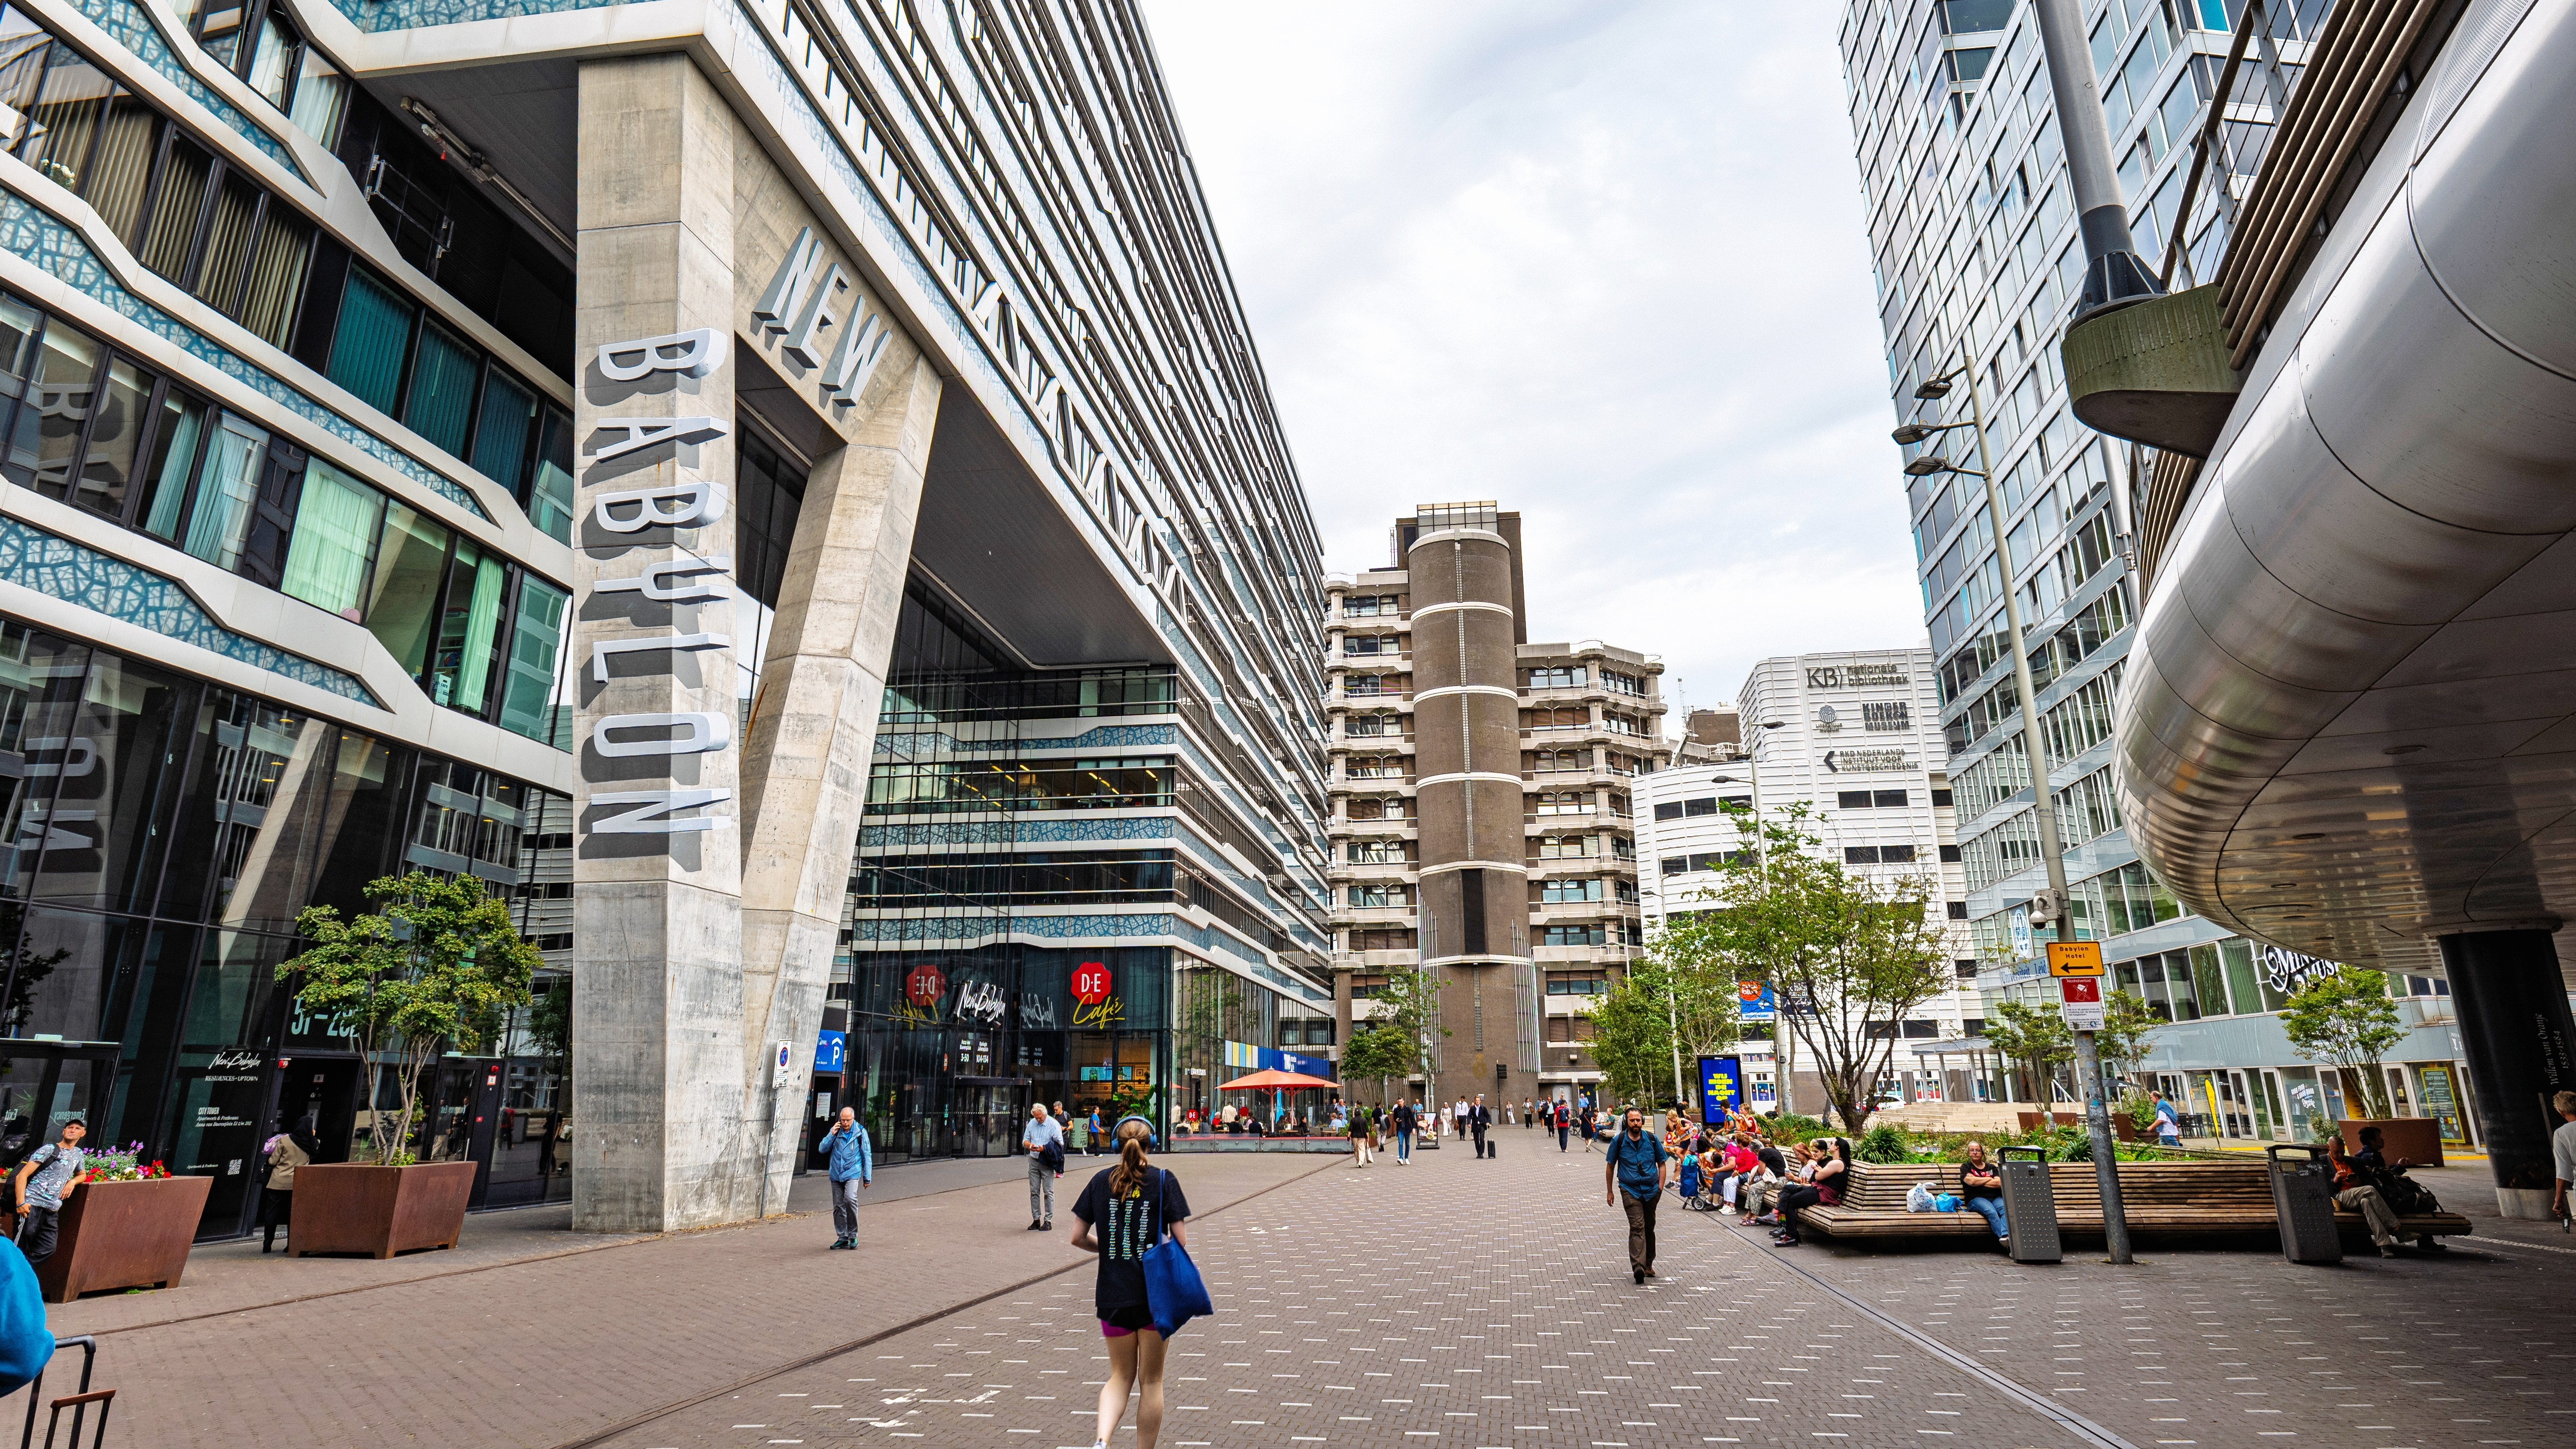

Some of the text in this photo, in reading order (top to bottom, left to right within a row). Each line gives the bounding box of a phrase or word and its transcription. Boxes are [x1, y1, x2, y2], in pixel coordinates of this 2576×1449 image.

[751, 226, 893, 407] NEW
[591, 327, 731, 834] BABYLON
[1847, 662, 1897, 674] nationale
[1847, 673, 1909, 686] bibliotheek
[1862, 702, 1908, 712] KINDER
[1865, 721, 1910, 731] MUSEUM
[1857, 748, 1905, 757] NEDERLANDS
[1841, 762, 1918, 772] KUNSTGESCHIEDENIS
[2001, 964, 2031, 984] Universiteit
[957, 980, 1006, 1023] New Babylon
[833, 1046, 840, 1065] P
[2534, 1013, 2559, 1085] Willem van Oranje
[2553, 1031, 2570, 1069] 1533-1584
[208, 1051, 261, 1070] New Babylon
[960, 1053, 969, 1062] 3-50
[976, 1054, 989, 1063] 104-134
[198, 1107, 207, 1115] CITY
